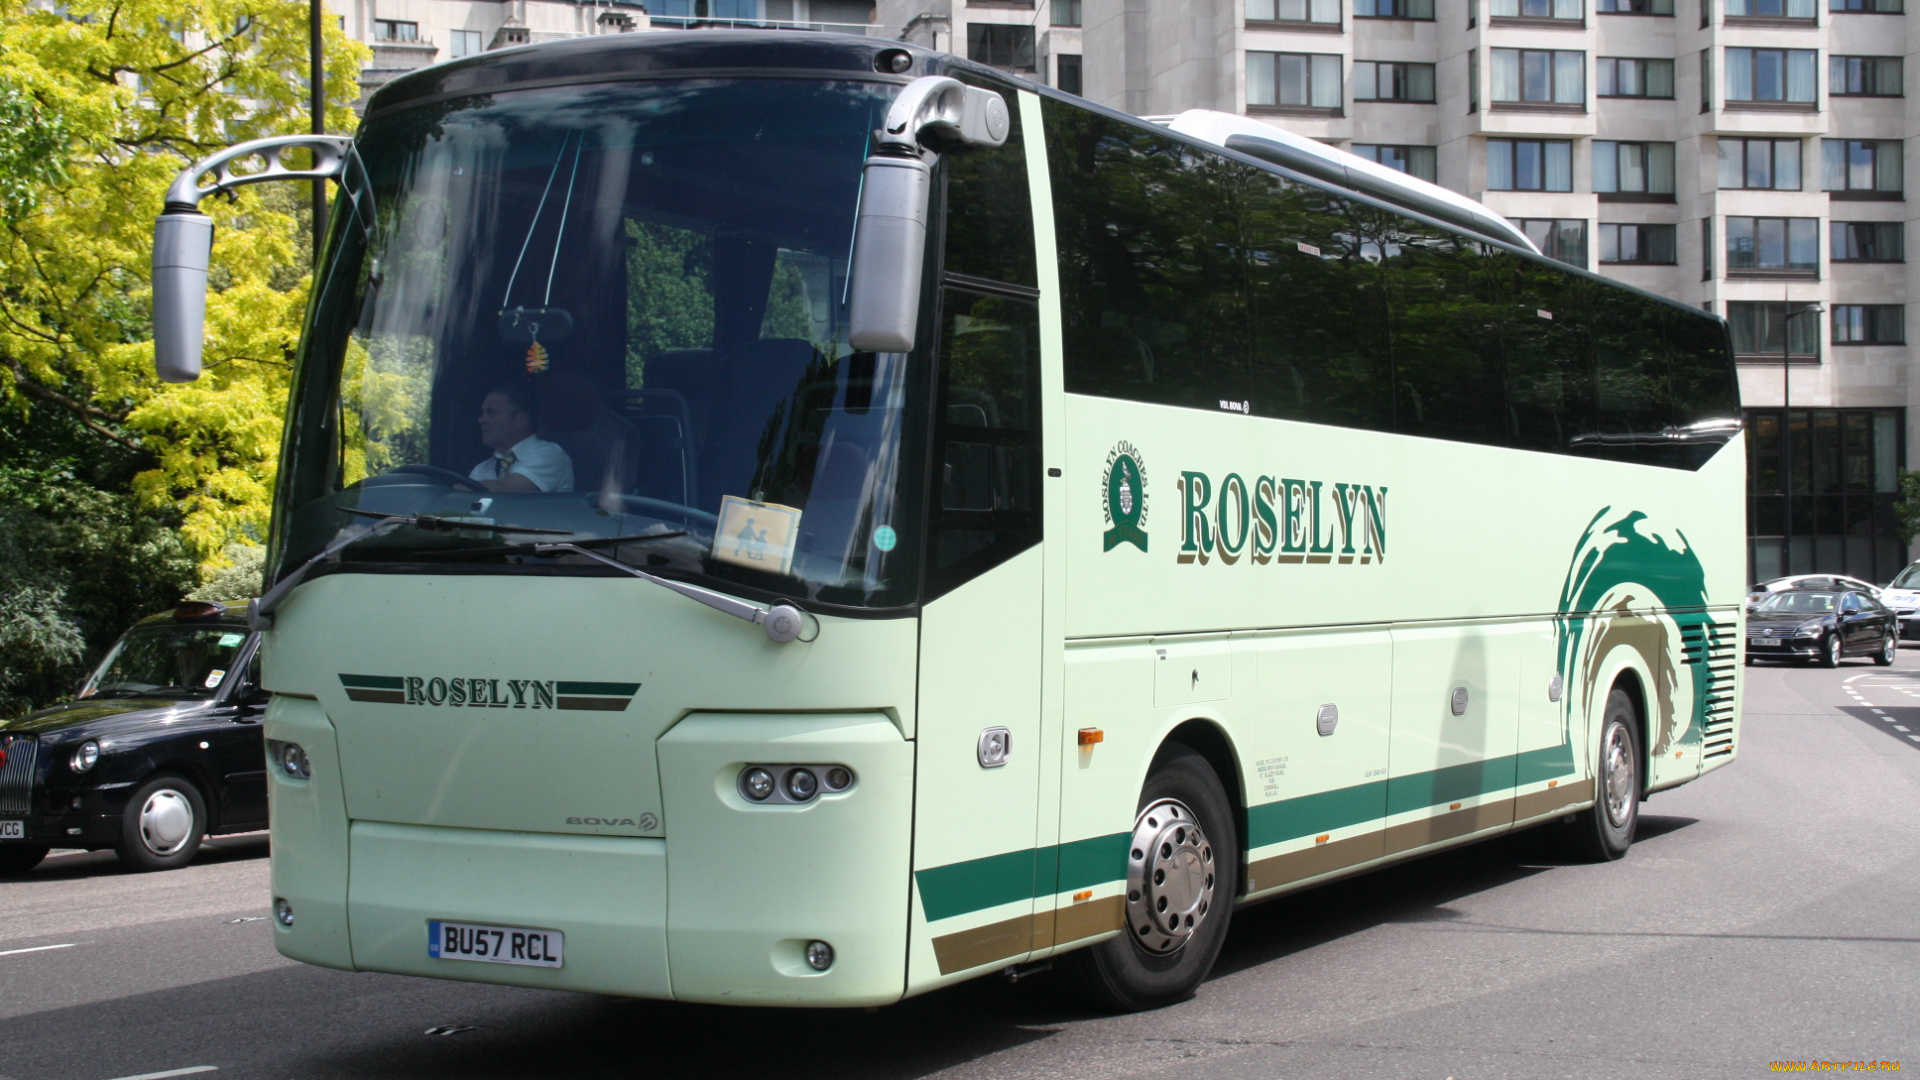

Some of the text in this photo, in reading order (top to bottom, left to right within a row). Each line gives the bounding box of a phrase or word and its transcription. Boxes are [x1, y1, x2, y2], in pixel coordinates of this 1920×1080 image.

[1102, 445, 1118, 525] ROSELYN
[1117, 440, 1149, 488] COACHES
[1177, 471, 1388, 566] ROSELYN
[405, 676, 555, 710] ROSELYN
[566, 817, 636, 826] BOVA
[444, 926, 557, 962] BU57 RCL
